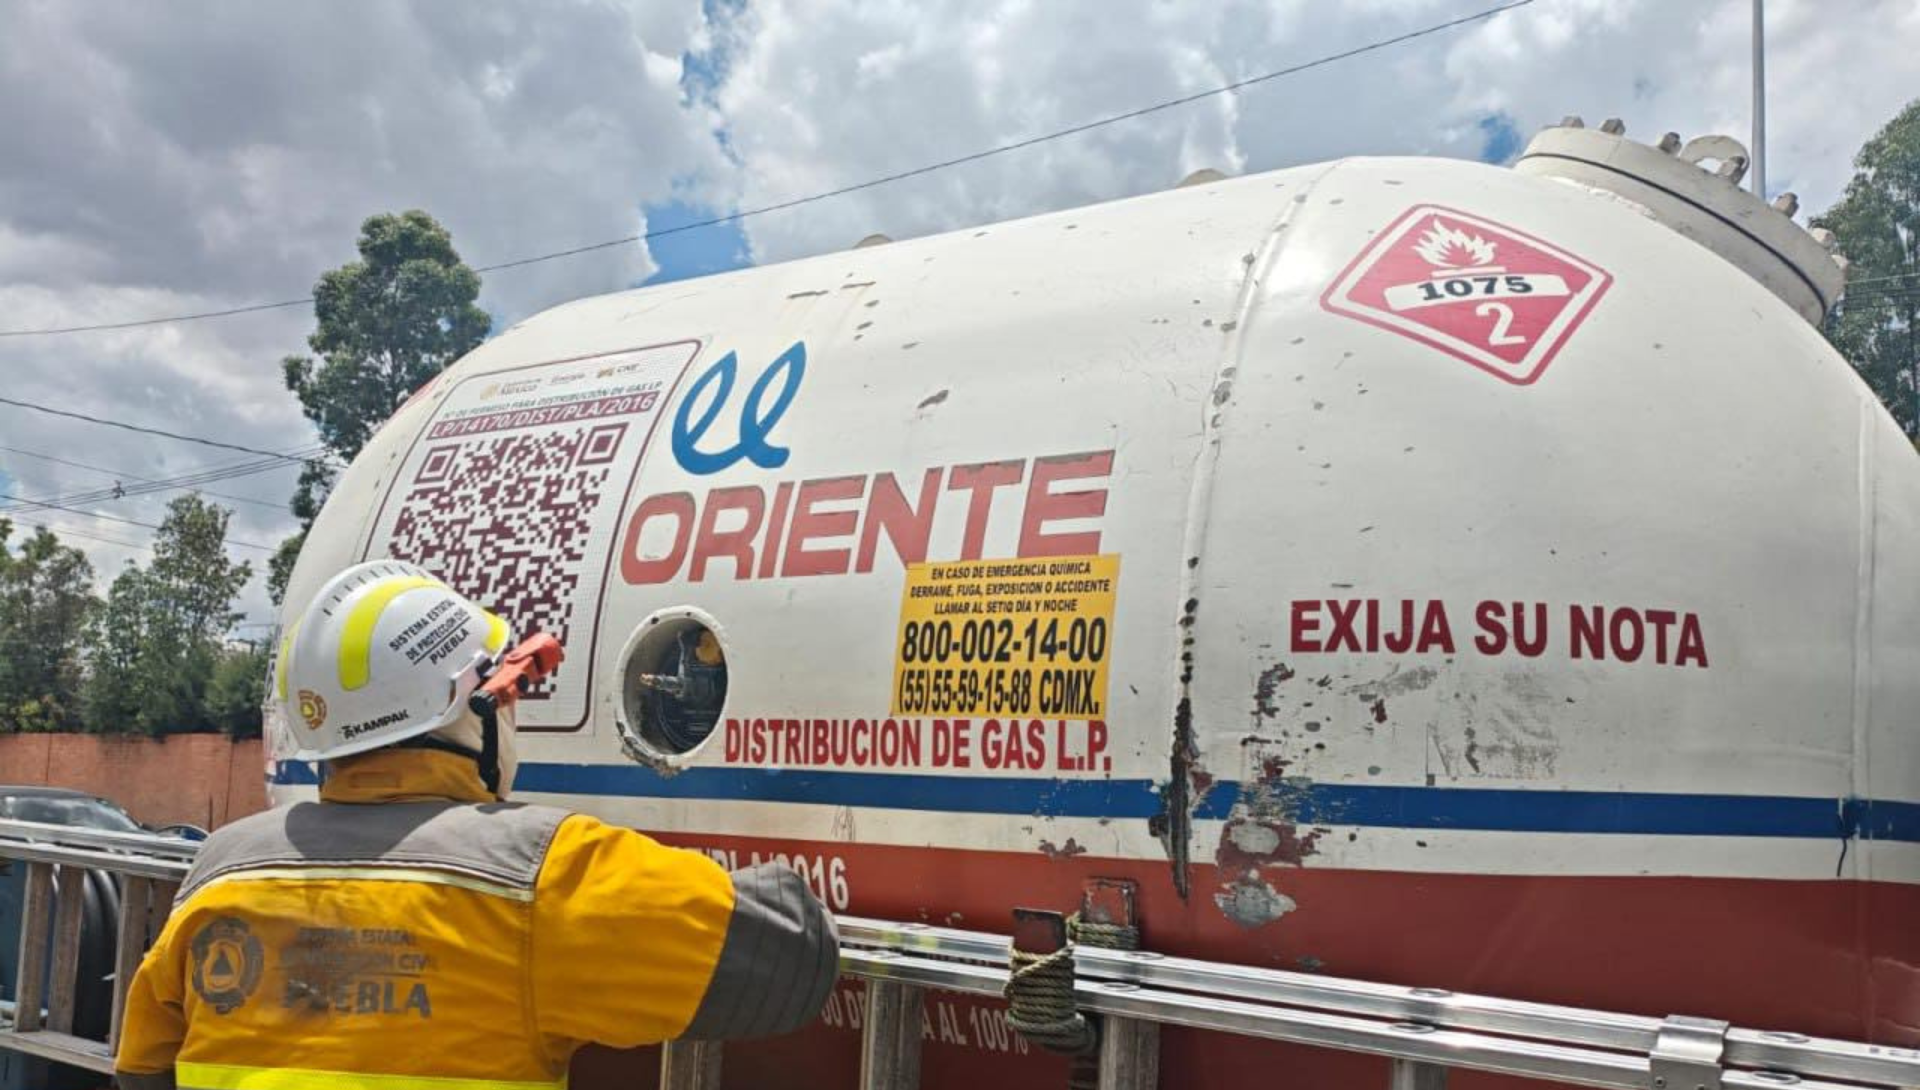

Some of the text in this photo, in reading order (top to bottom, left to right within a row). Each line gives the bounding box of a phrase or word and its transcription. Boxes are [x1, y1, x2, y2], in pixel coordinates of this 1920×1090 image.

[1417, 275, 1534, 301] 1075
[1475, 302, 1526, 347] 2
[432, 393, 655, 437] LP/14170/DIST/PLA/2016
[620, 450, 1116, 585] ORIENTE
[932, 567, 944, 580] EN
[946, 566, 970, 579] CASO
[972, 565, 985, 578] DE
[986, 563, 1046, 577] EMERGENCIA
[1045, 581, 1052, 594] O
[1054, 579, 1111, 593] ACCIDENTE
[934, 602, 969, 615] LLAMAR
[971, 601, 984, 614] AL
[986, 600, 1013, 614] SETIQ
[1034, 599, 1042, 612] Y
[1043, 599, 1078, 612] NOCHE
[389, 617, 430, 651] SISTEMA
[429, 628, 469, 665] PUEBLA
[902, 617, 1107, 663] 800-002-14-00
[1290, 598, 1709, 668] EXIJA SU NOTA
[405, 647, 421, 660] DE
[1039, 668, 1100, 715] CDMX.
[932, 719, 970, 769] DE
[981, 718, 1045, 771] GAS
[1057, 719, 1112, 771] L.P.
